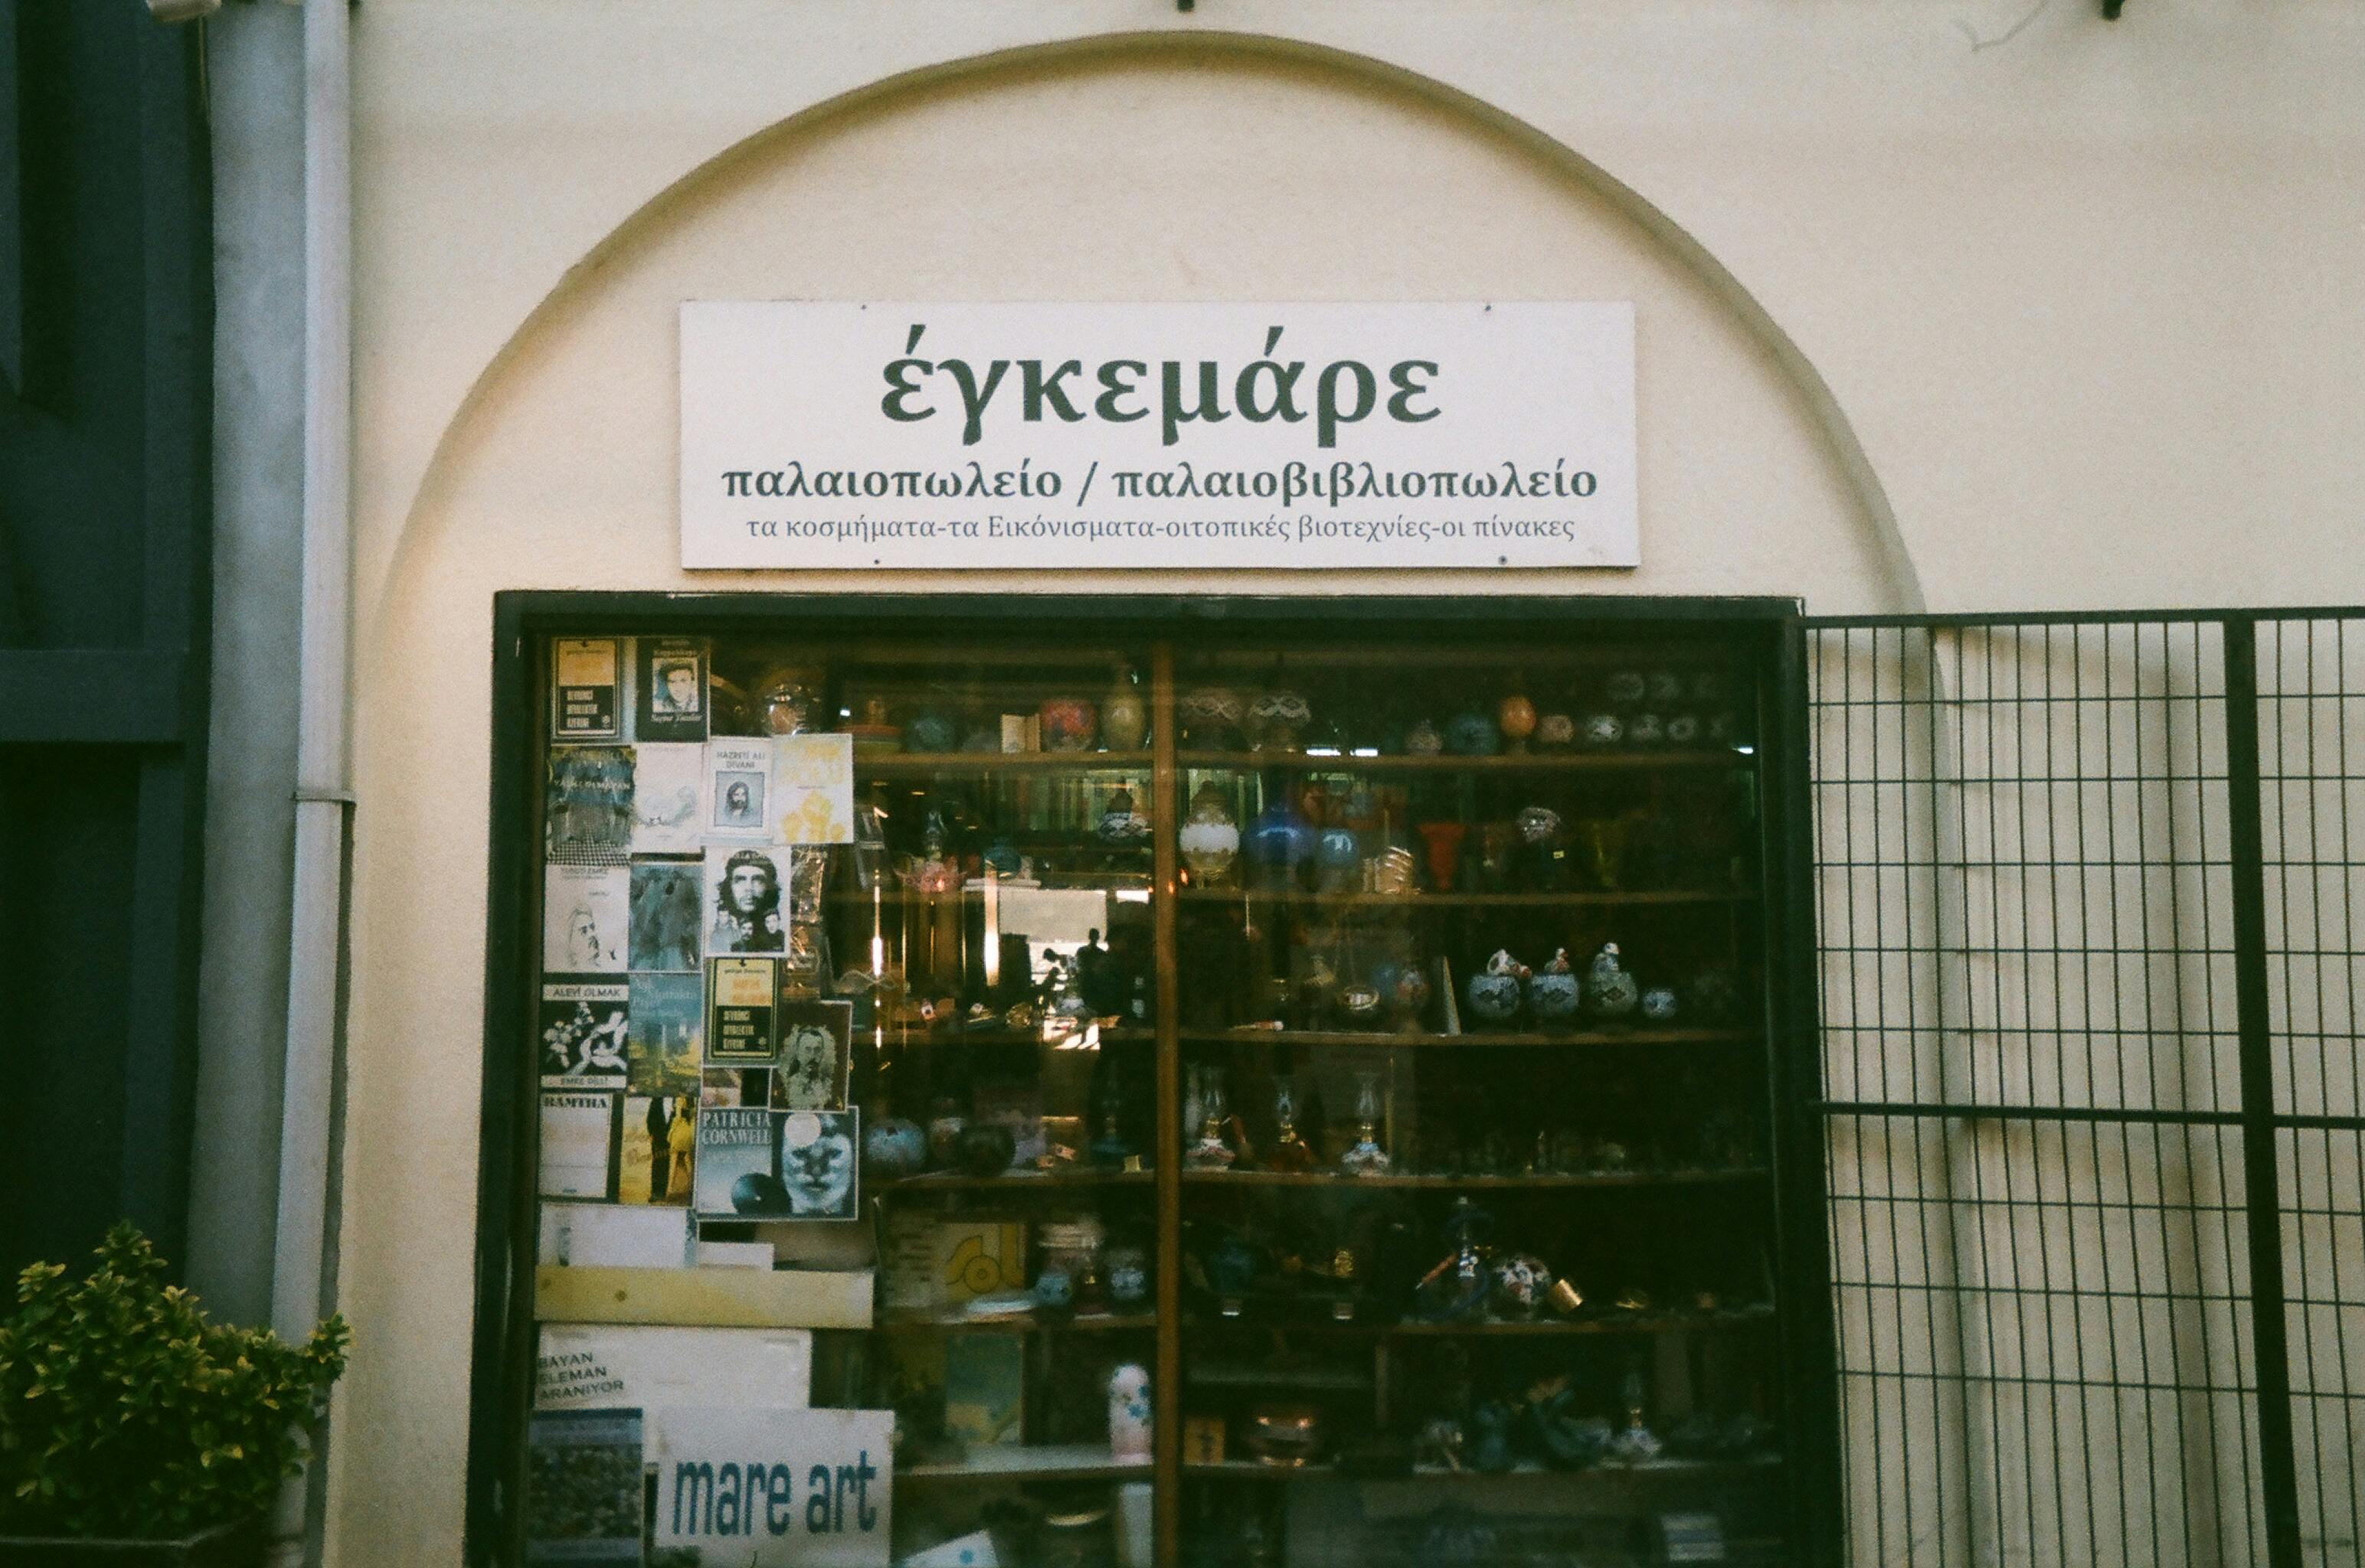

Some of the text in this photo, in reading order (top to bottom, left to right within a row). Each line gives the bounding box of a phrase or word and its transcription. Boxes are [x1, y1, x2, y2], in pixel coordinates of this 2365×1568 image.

[881, 323, 1441, 449] έγκεμάρε
[722, 459, 1597, 507] παλαιοπωλείο / παλαιοβιβλιοπωλείο
[747, 521, 777, 537] τα
[786, 514, 980, 542] κοσμήματα-τα
[1298, 514, 1466, 544] βιοτεχνίες-οι
[1474, 514, 1575, 543] πίνακες
[584, 987, 621, 998] OLMAK
[703, 1112, 771, 1129] PATRICIA
[702, 1129, 771, 1145] CORNWELL
[538, 1352, 594, 1369] BAYAN
[538, 1366, 607, 1385] ELEMAN
[538, 1380, 624, 1400] ARANIYOR
[672, 1449, 877, 1536] mare art
